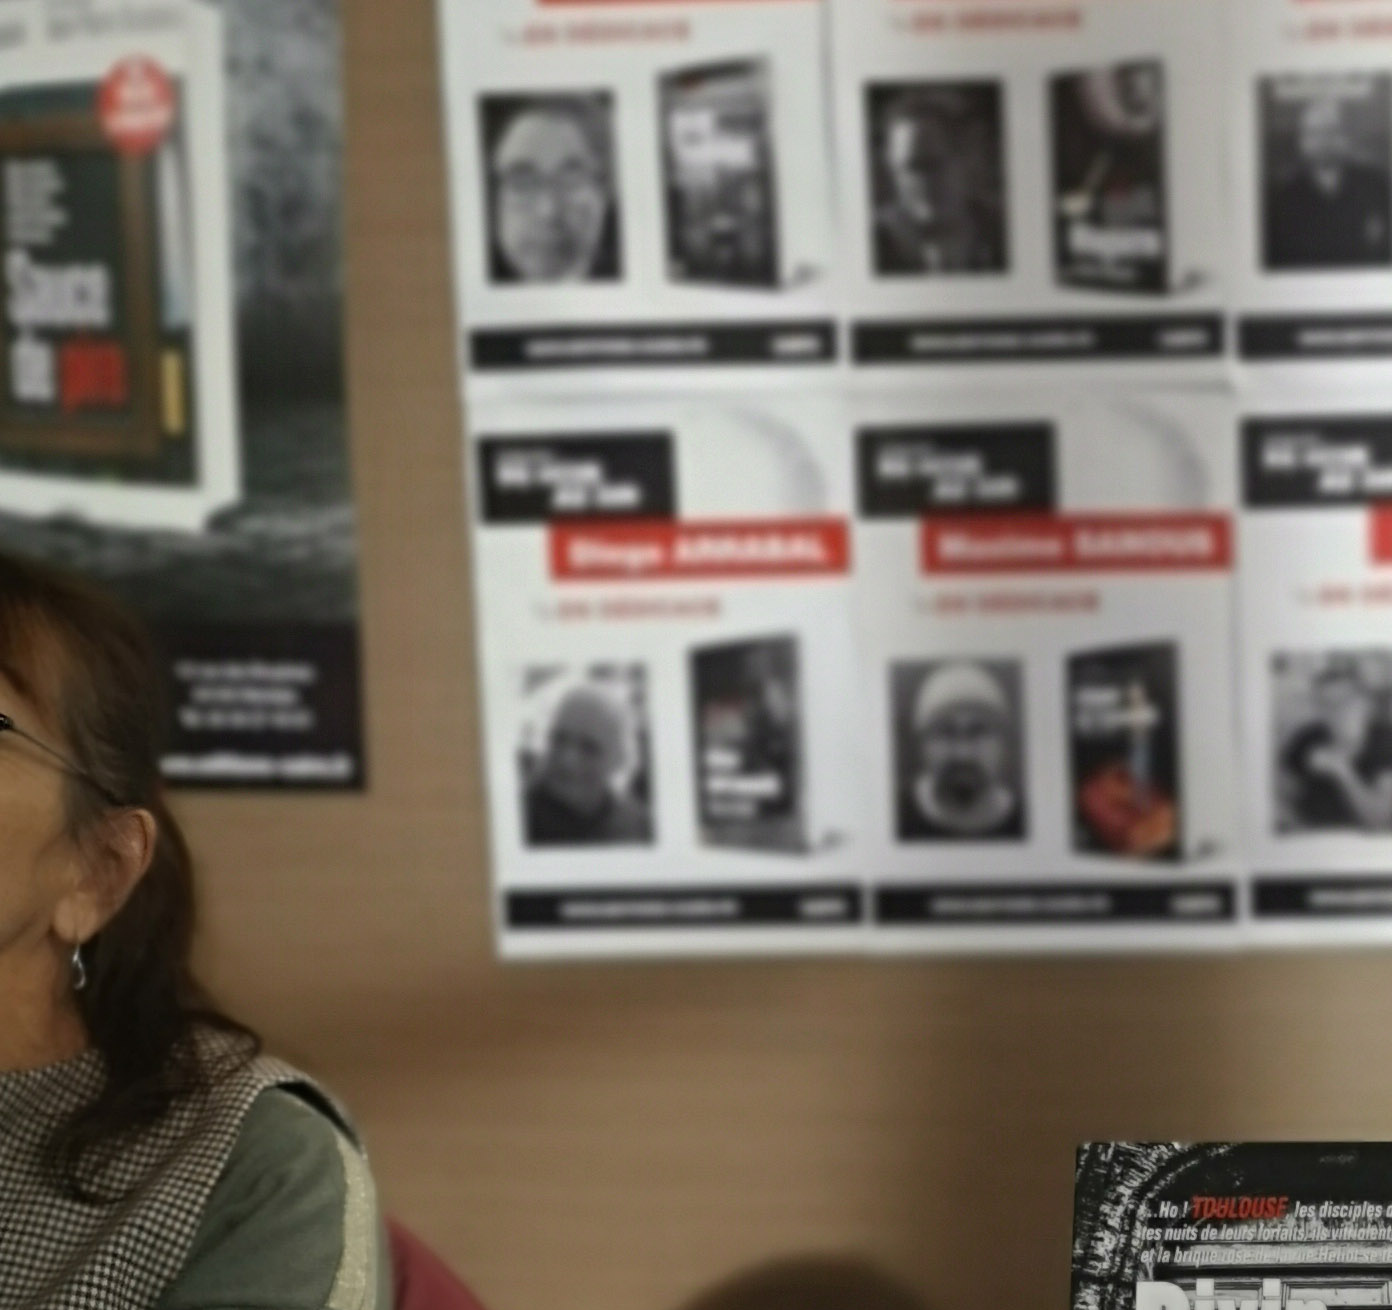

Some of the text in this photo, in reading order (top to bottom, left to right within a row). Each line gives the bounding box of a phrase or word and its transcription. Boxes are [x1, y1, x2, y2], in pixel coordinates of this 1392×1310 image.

[1295, 1201, 1315, 1218] les
[1319, 1200, 1383, 1221] disciples
[1165, 1223, 1199, 1241] nuits
[1201, 1223, 1219, 1241] de
[1141, 1247, 1155, 1263] et
[1157, 1247, 1170, 1263] la
[1174, 1246, 1218, 1268] brique
